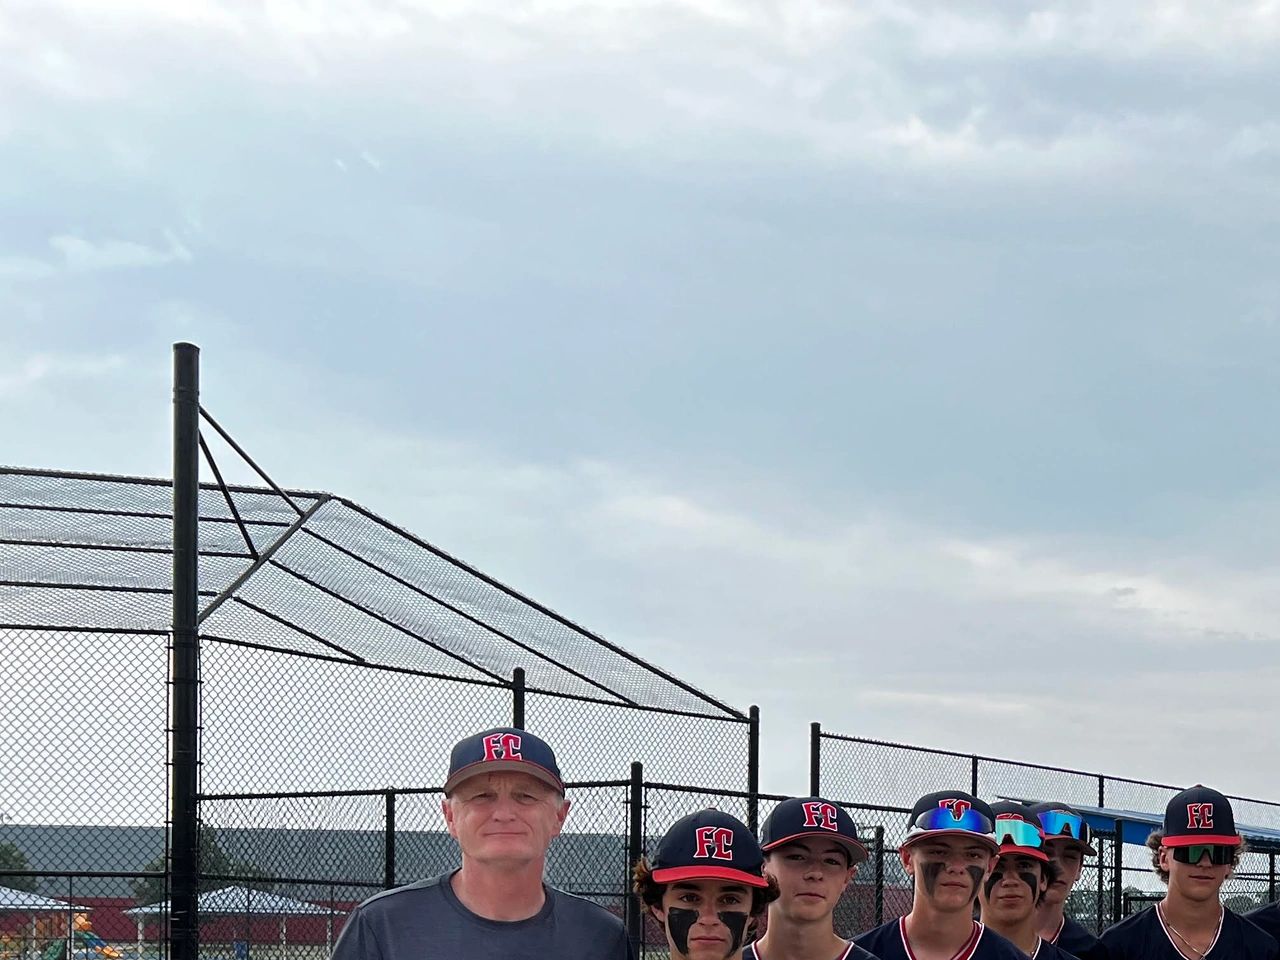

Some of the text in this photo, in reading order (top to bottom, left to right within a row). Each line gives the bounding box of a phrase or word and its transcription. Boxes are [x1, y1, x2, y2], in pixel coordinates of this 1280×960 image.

[483, 733, 522, 761] FC
[801, 801, 838, 832] FC
[1187, 803, 1214, 829] FC
[693, 826, 734, 861] FC
